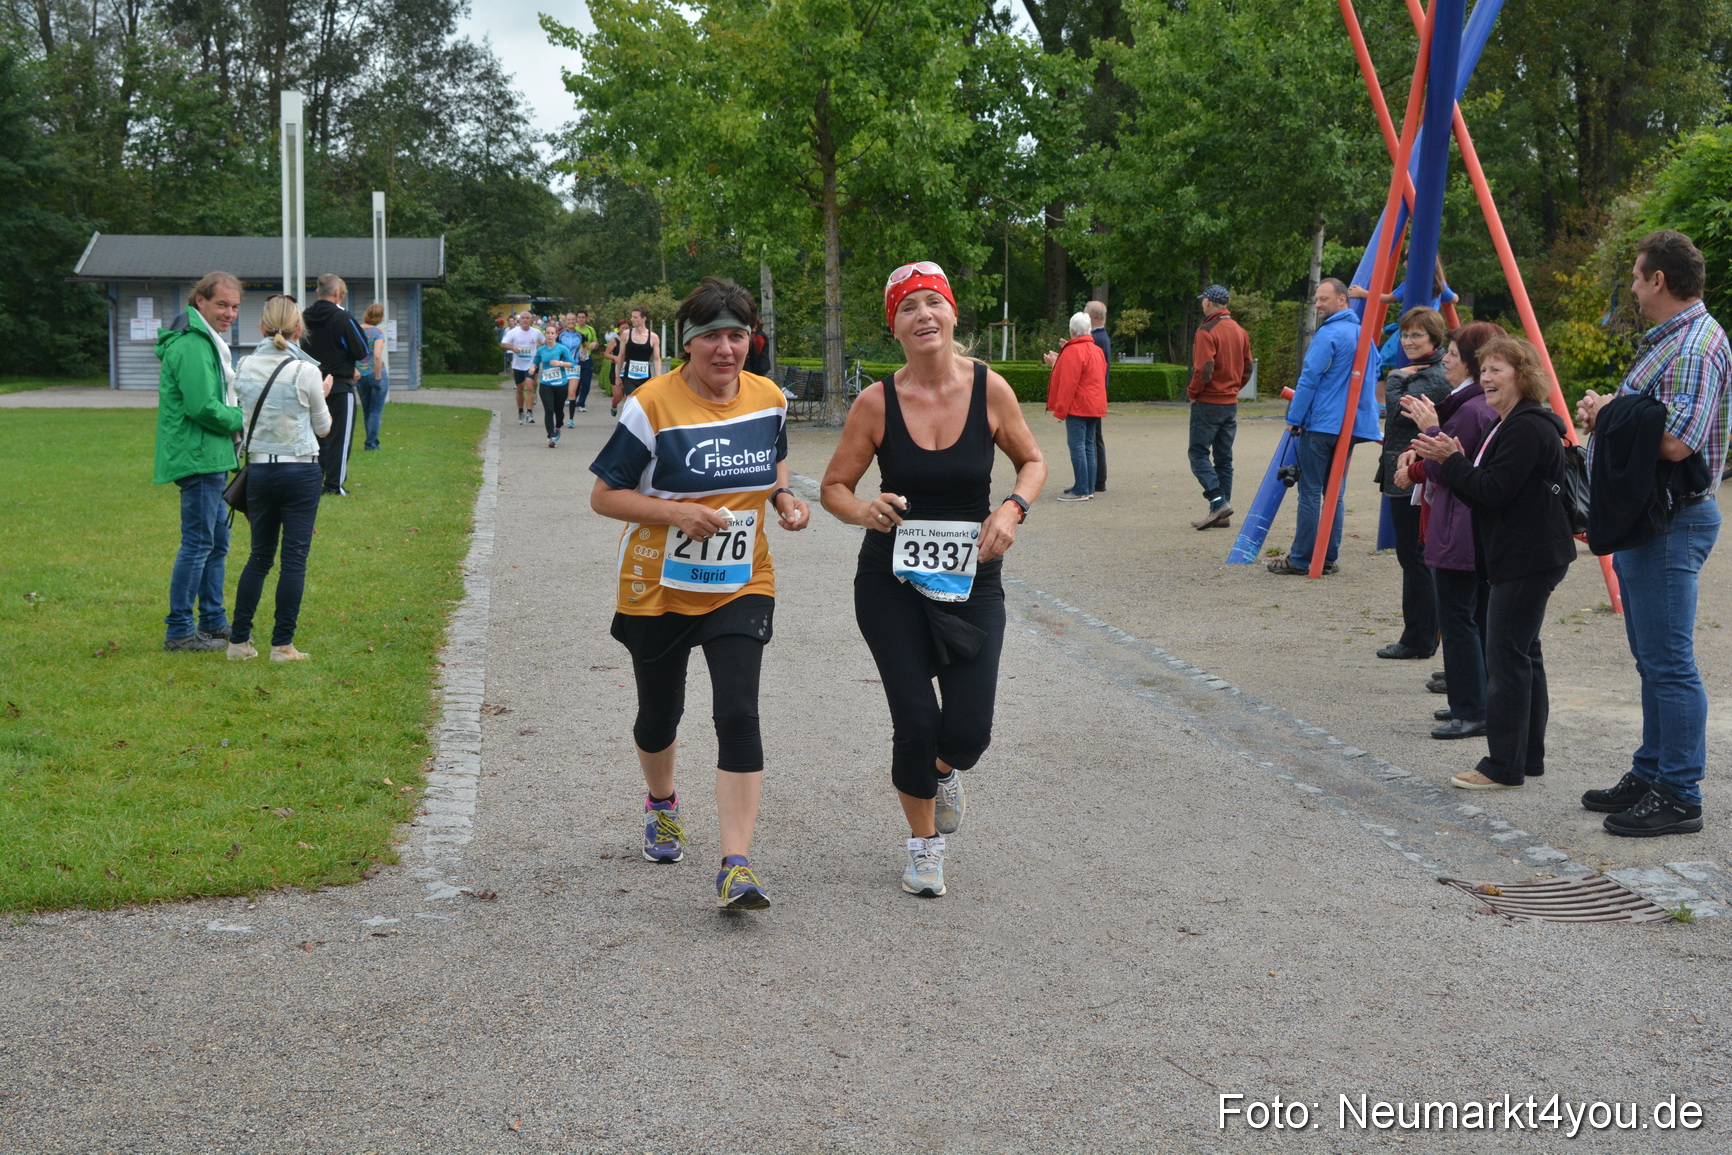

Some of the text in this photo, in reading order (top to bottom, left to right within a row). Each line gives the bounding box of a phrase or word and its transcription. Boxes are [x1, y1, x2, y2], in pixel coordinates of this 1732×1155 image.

[631, 364, 647, 373] 2943
[704, 449, 772, 469] Fischer
[713, 463, 771, 478] AUTOMOBILE
[727, 518, 743, 527] arkt
[898, 528, 969, 538] PARTL Neumarkt
[674, 530, 747, 561] 2176
[903, 540, 973, 572] 3337
[690, 568, 726, 583] Sigrid
